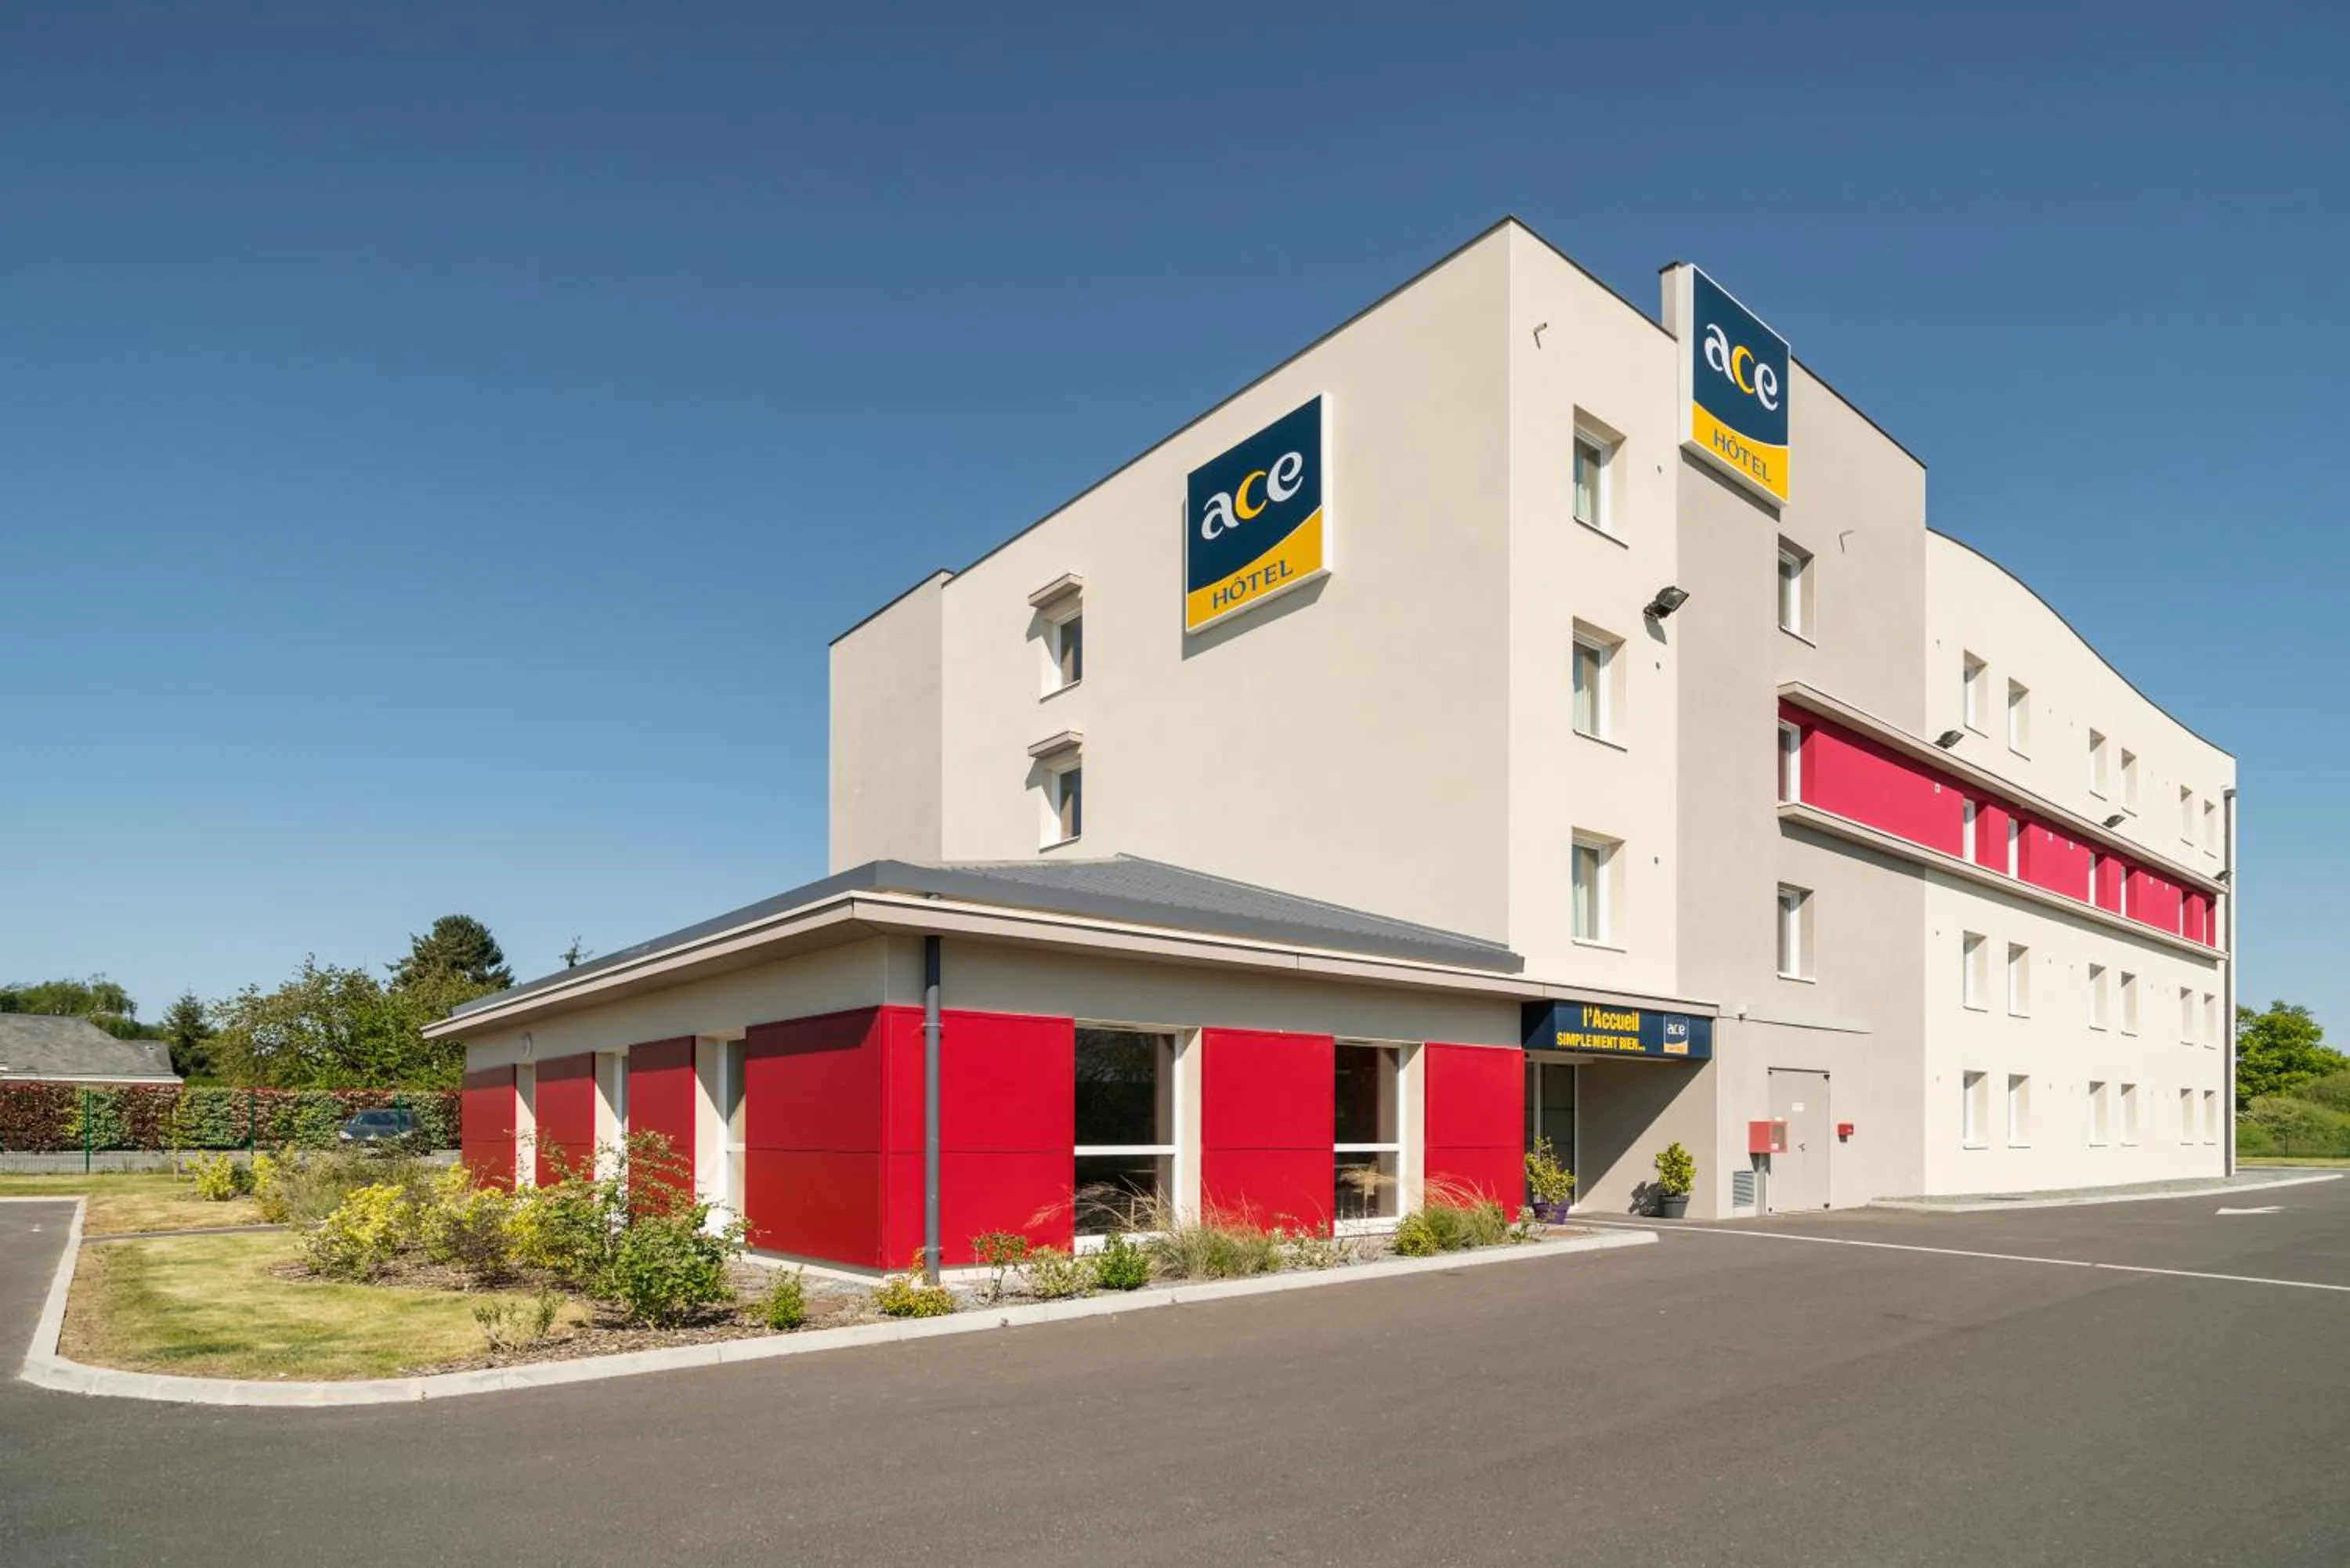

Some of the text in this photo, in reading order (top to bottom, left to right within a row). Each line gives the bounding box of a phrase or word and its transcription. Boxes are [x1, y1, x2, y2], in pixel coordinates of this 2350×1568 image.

[1704, 323, 1779, 411] ace
[1713, 428, 1772, 482] HÔTEL
[1201, 451, 1304, 540] ace
[1212, 559, 1293, 609] HÔTEL
[1666, 1023, 1685, 1036] ace
